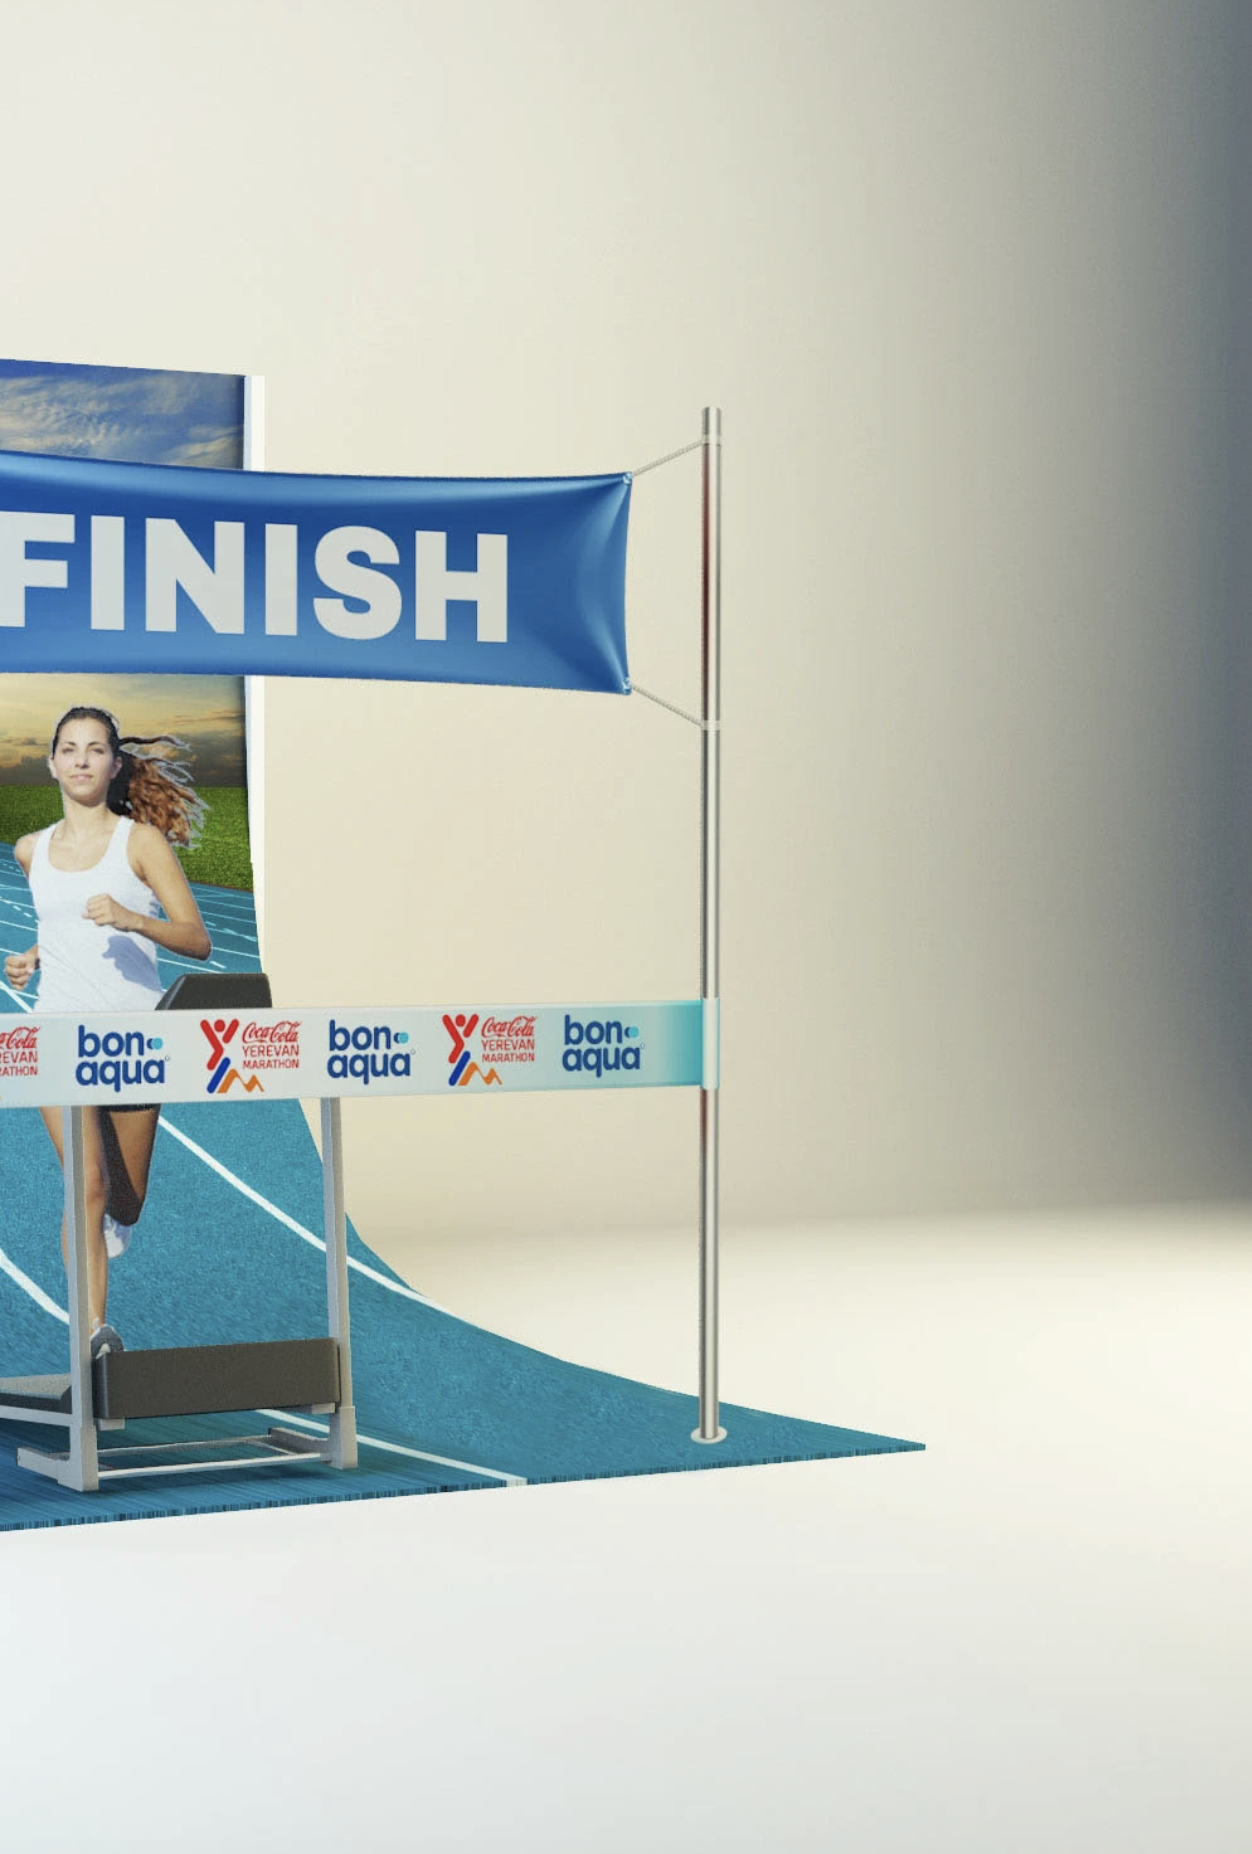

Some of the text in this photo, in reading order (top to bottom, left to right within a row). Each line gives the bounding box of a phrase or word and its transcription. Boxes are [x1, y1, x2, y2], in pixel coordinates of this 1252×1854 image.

[78, 1024, 145, 1057] bon
[242, 1020, 302, 1044] Coca-Cola
[329, 1019, 392, 1051] bon
[481, 1014, 538, 1039] Coca-Cola
[564, 1014, 623, 1046] bon
[242, 1044, 300, 1057] YEREVAN
[481, 1039, 536, 1051] YEREVAN
[481, 1053, 535, 1063] MARATHON
[75, 1058, 165, 1093] aqua
[242, 1058, 300, 1070] MARATHON
[327, 1052, 411, 1085] aqua
[562, 1045, 641, 1078] aqua
